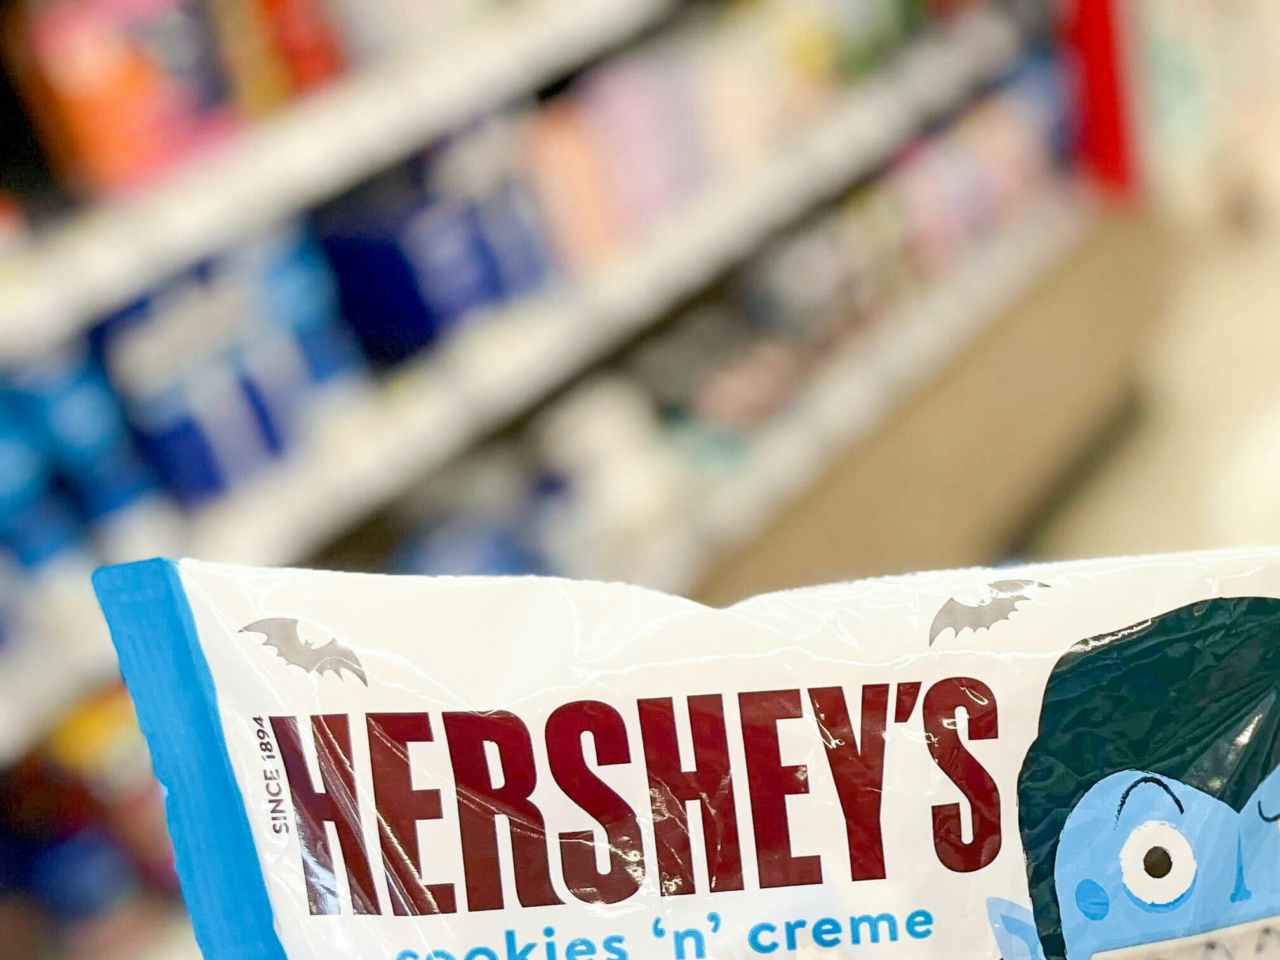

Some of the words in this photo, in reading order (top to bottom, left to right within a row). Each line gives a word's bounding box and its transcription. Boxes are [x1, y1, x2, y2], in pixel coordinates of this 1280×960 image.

[252, 713, 276, 761] 1894
[263, 768, 289, 834] SINCE
[269, 676, 1002, 917] HERSHEY'S
[748, 908, 934, 953] creme
